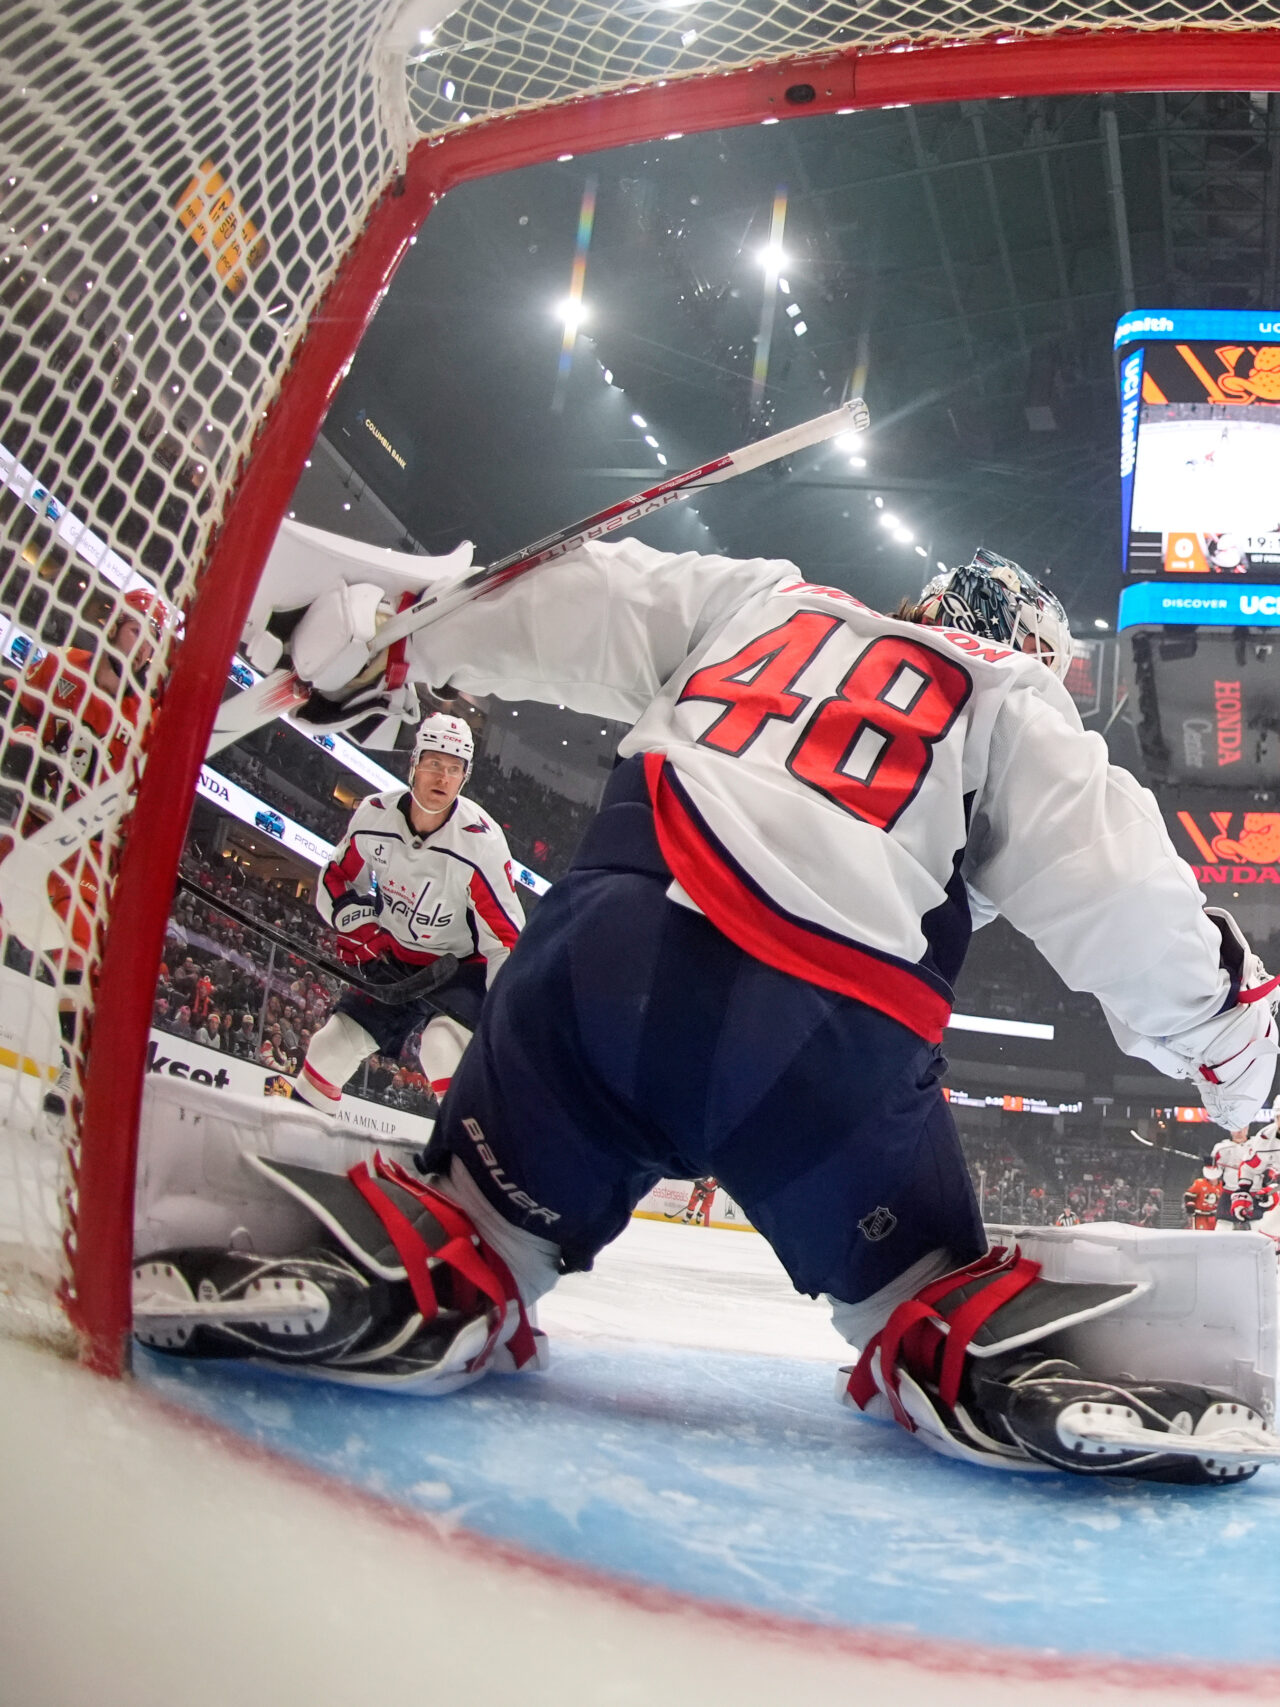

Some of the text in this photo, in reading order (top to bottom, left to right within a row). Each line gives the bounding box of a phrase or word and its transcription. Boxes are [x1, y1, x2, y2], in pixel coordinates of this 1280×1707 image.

[1123, 358, 1141, 400] UCI
[365, 419, 406, 470] COLUMBIA BANK
[1174, 538, 1194, 558] 0
[1162, 598, 1228, 610] DISCOVER
[675, 609, 973, 833] 48
[1214, 679, 1242, 767] HONDA
[443, 734, 463, 744] CCM
[198, 772, 230, 803] NDA
[294, 833, 334, 863] PROLOG
[382, 885, 416, 907] WASHINGTON
[383, 881, 454, 941] apitals
[341, 908, 380, 927] BAUE
[146, 1041, 230, 1089] kset
[381, 1122, 397, 1134] LLP
[461, 1118, 562, 1225] BAUER
[653, 1187, 690, 1203] easterseals
[871, 1214, 886, 1237] NHL
